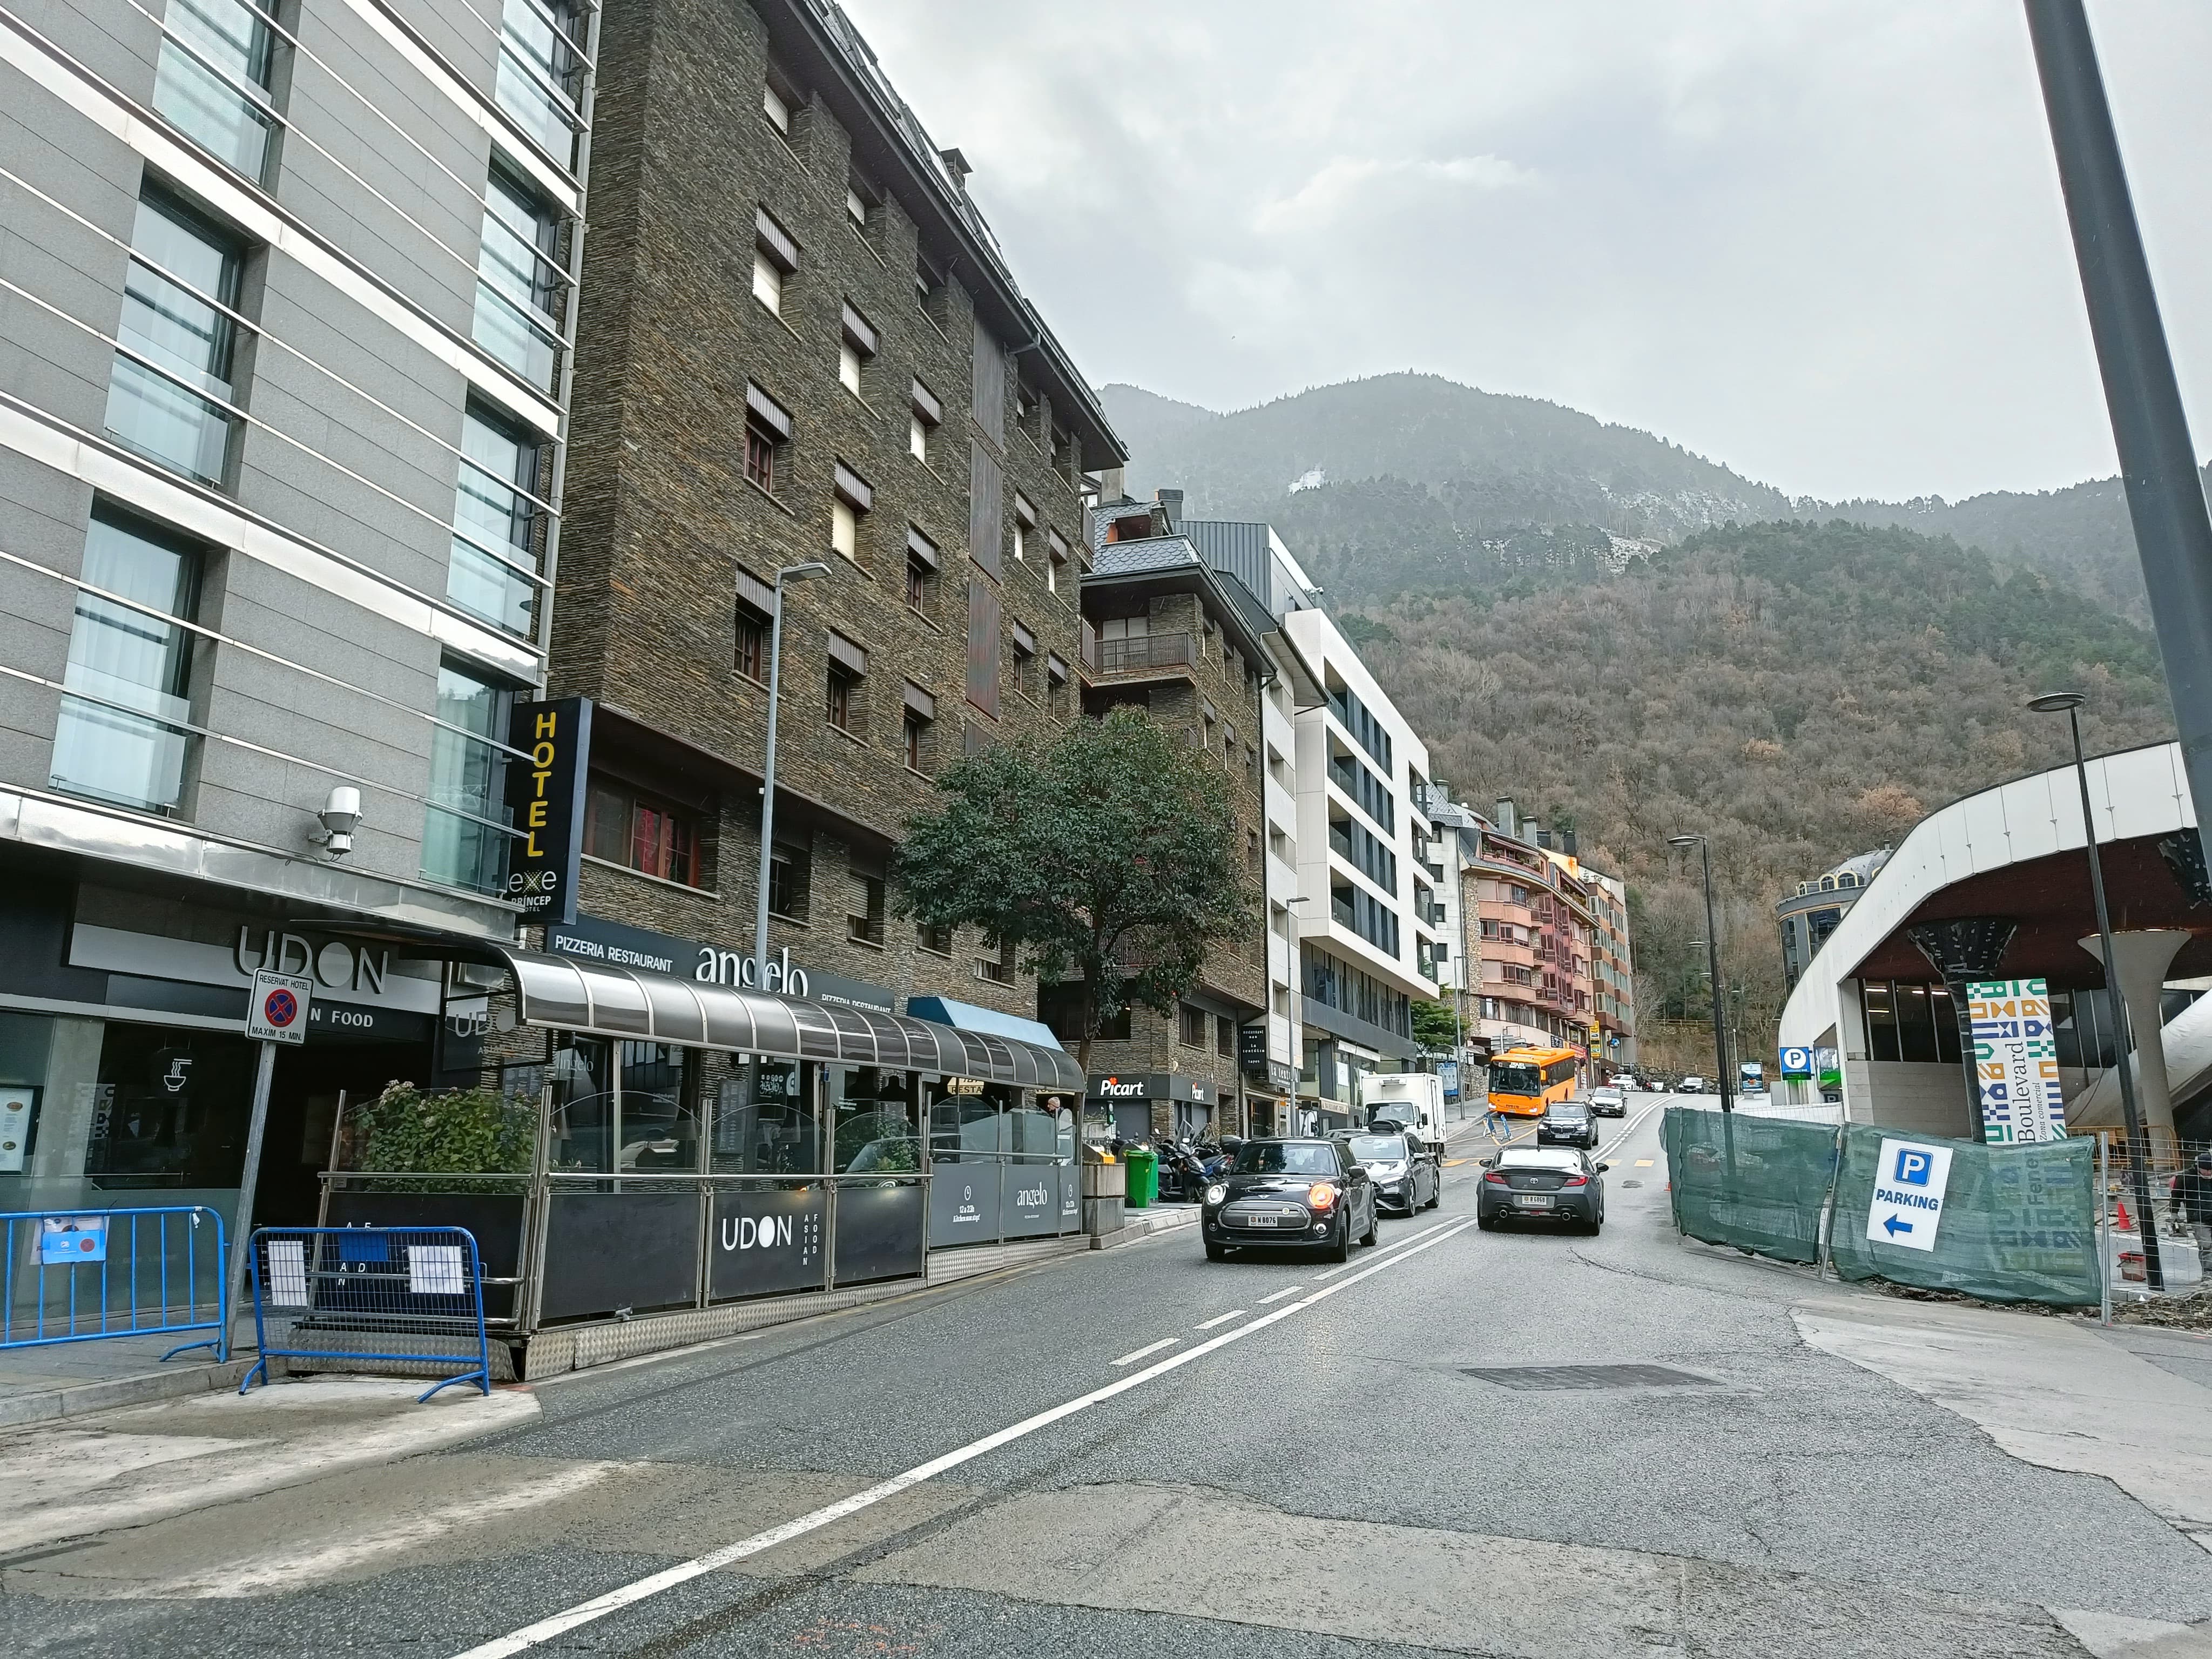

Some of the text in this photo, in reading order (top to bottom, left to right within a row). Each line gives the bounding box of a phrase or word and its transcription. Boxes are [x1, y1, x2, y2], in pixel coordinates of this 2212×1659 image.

[528, 712, 556, 857] HOTEL
[509, 869, 557, 893] exe
[239, 925, 389, 994] UDON
[555, 934, 673, 972] PIZZERIA RESTAURANT
[259, 974, 309, 990] RESERVAT HOTEL
[332, 1010, 374, 1027] FOOD
[288, 1032, 302, 1042] MIN.
[1790, 1052, 1801, 1065] P
[1100, 1076, 1144, 1096] Picart
[1191, 1082, 1204, 1101] Picart
[2005, 1041, 2035, 1143] Boulevard
[2032, 1082, 2047, 1141] Zona comercial
[1902, 1154, 1925, 1179] P
[1017, 1181, 1048, 1209] angelo
[1876, 1189, 1939, 1211] PARKING
[722, 1215, 792, 1251] UDON
